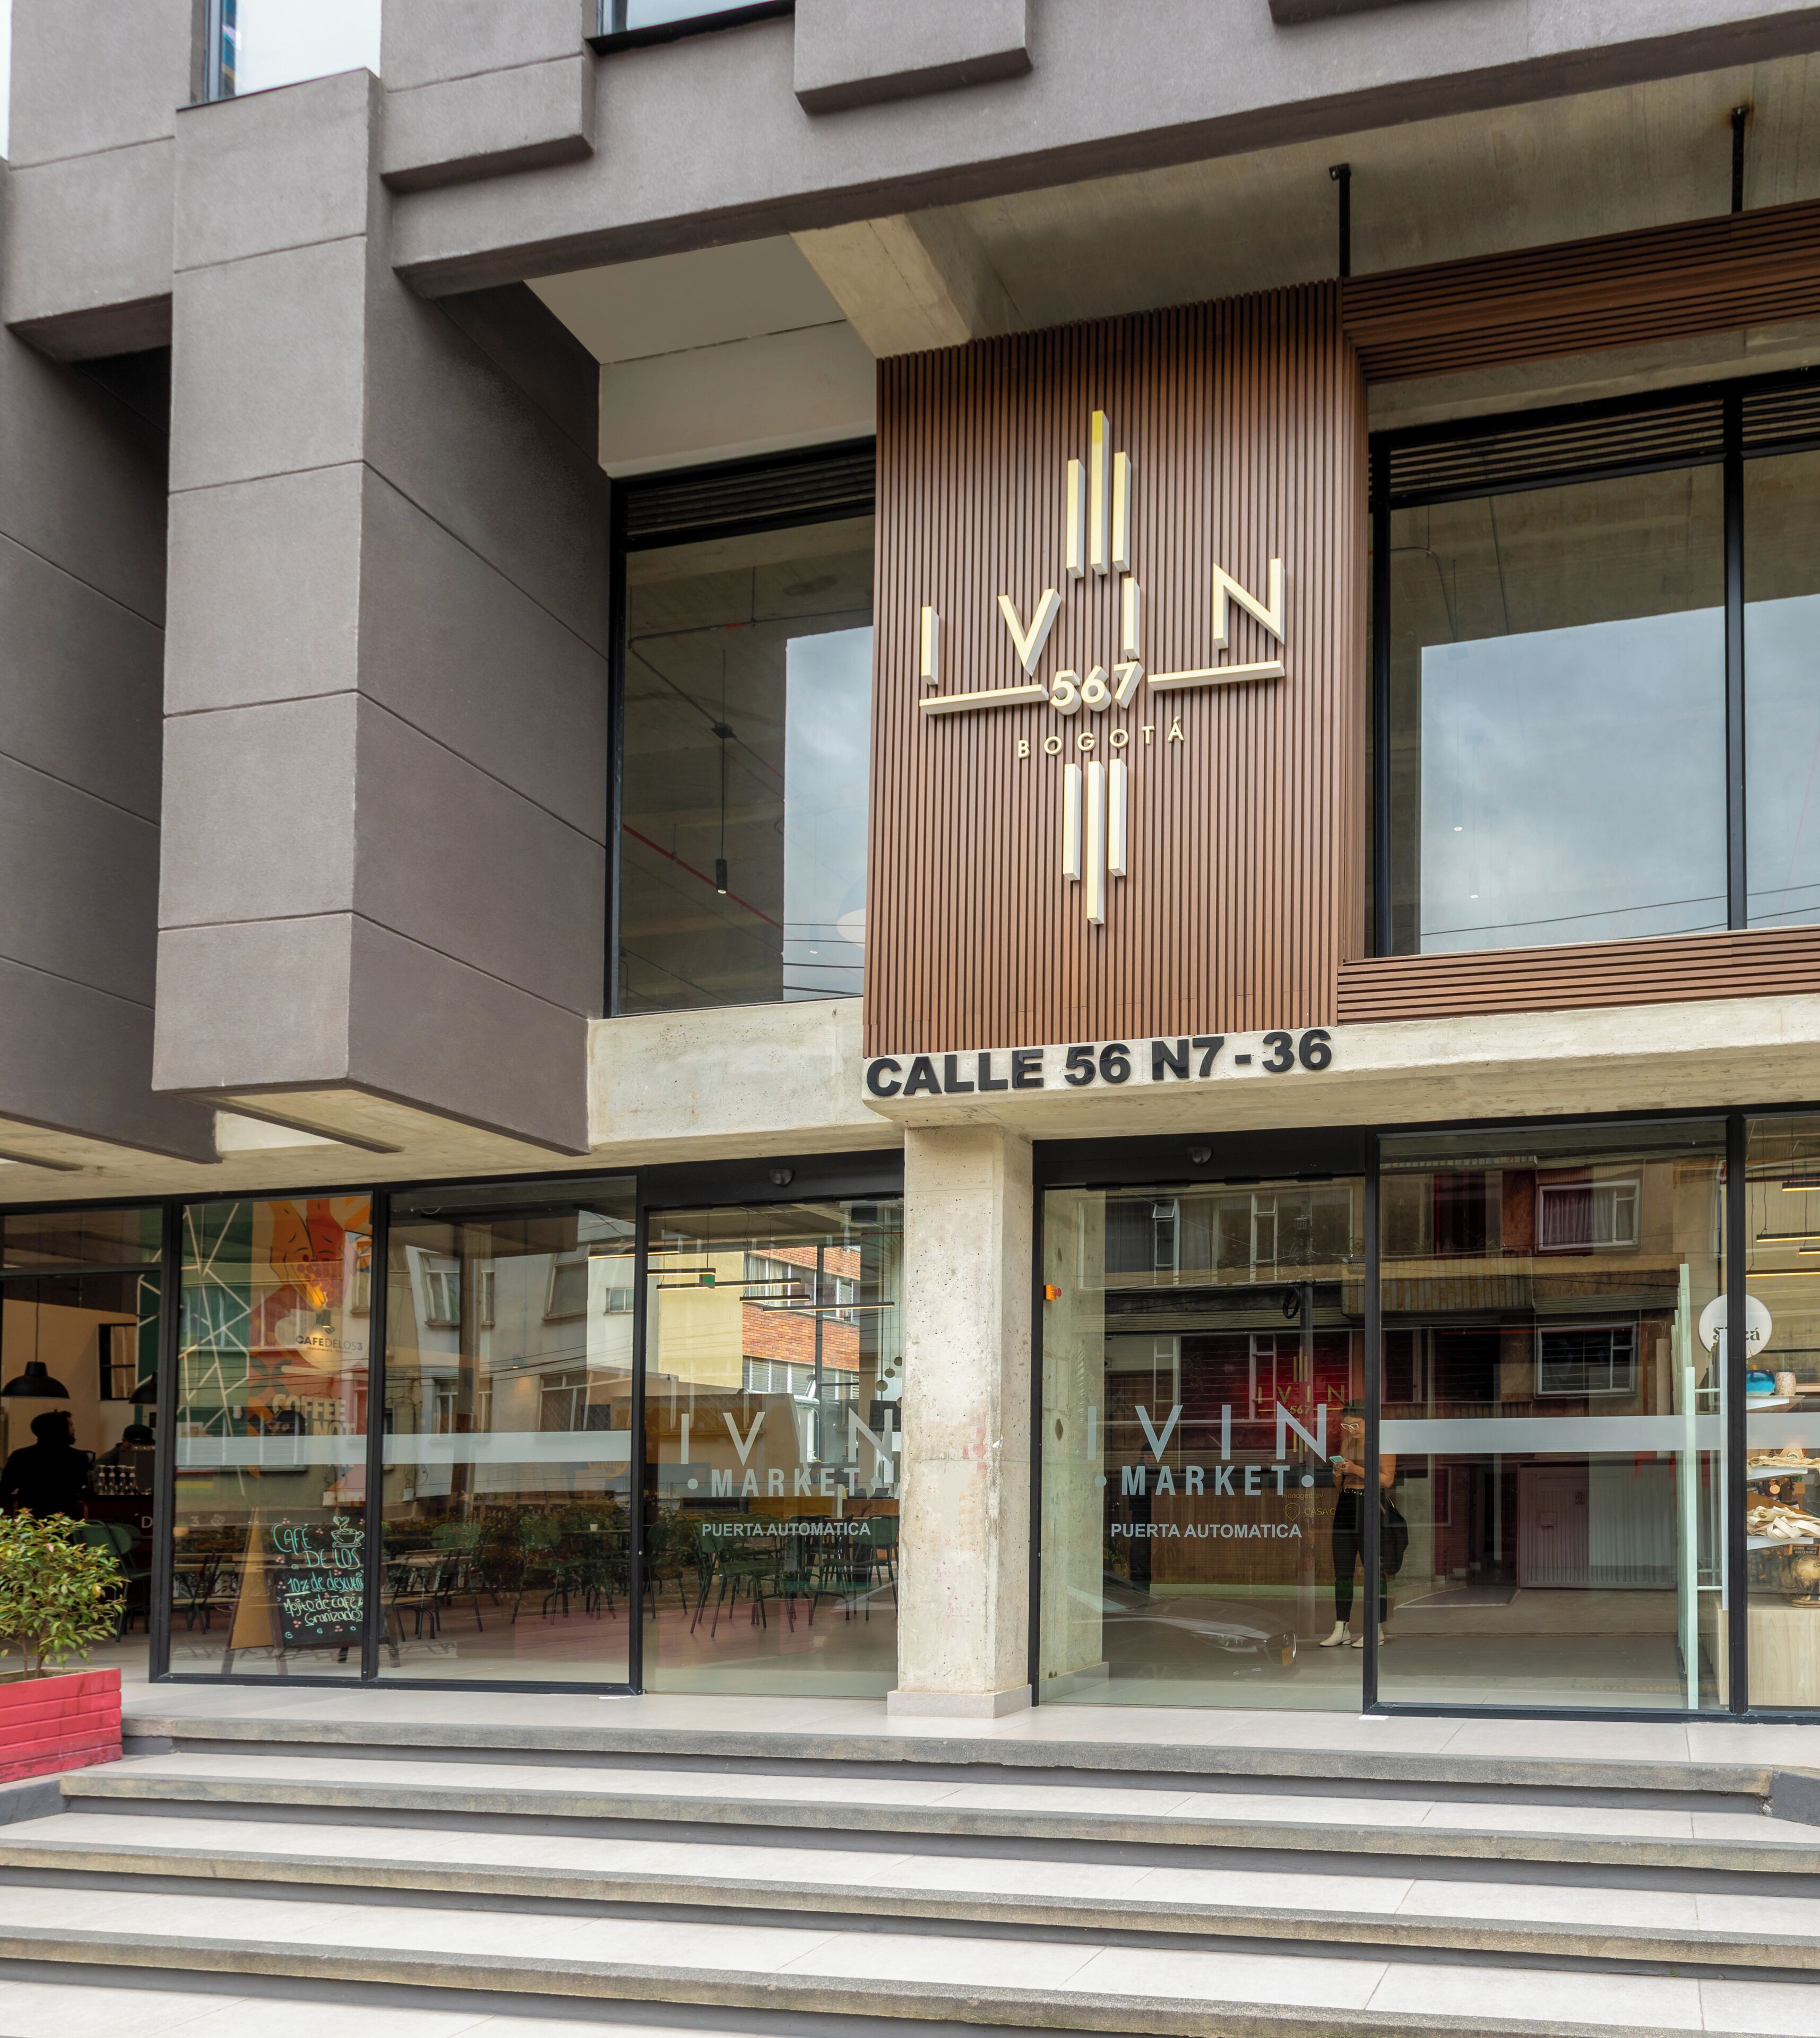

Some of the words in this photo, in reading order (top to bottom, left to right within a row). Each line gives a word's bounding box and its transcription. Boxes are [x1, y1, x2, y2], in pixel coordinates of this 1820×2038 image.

[921, 557, 1284, 685] IVIN
[1050, 661, 1143, 715] 567
[1017, 716, 1185, 758] BOGOTÁ
[866, 1049, 1043, 1096] CALLE
[1064, 1043, 1131, 1086] 56
[272, 1394, 346, 1421] COFFEE
[1258, 1384, 1345, 1404] IVIN
[1290, 1405, 1311, 1414] 567
[681, 1407, 893, 1466] IVIN
[1088, 1401, 1327, 1463] IVIN
[711, 1467, 860, 1497] MARKET
[1122, 1465, 1290, 1496] MARKET
[1282, 1492, 1313, 1500] managed
[272, 1523, 312, 1556] CAFÉ
[702, 1523, 764, 1537] PUERTA
[766, 1522, 871, 1536] AUTOMATICA
[1111, 1524, 1181, 1538] PUERTA
[1184, 1524, 1303, 1538] AUTOMATICA
[303, 1548, 332, 1569] DE
[333, 1548, 360, 1570] LOS
[288, 1578, 309, 1592] 10%
[310, 1571, 324, 1592] de
[283, 1597, 316, 1617] Mojito
[315, 1594, 331, 1610] de
[331, 1593, 358, 1611] café
